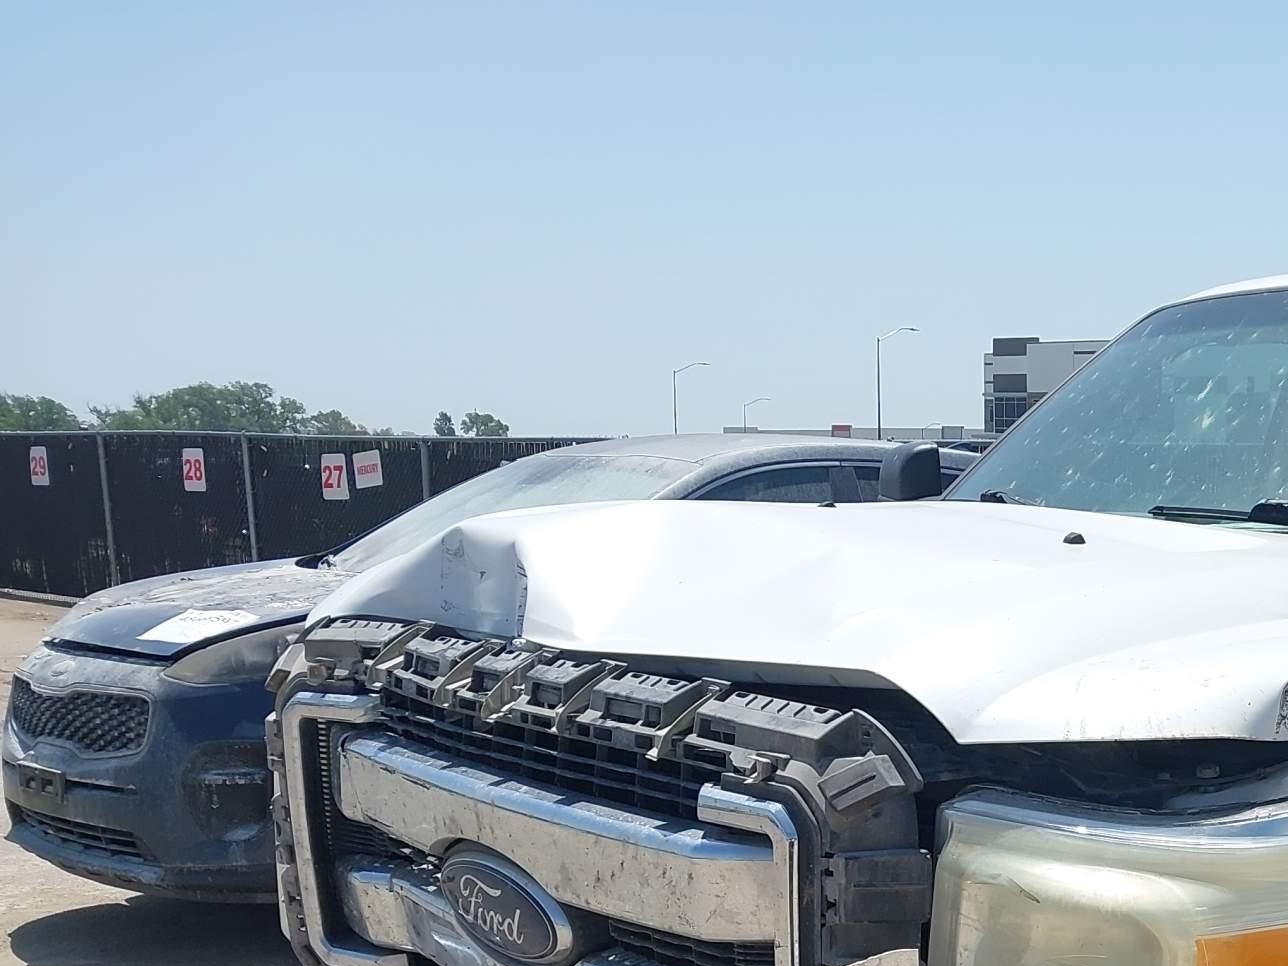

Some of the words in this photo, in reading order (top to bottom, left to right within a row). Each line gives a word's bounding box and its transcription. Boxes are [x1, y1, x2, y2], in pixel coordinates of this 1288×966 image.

[31, 456, 47, 476] 29
[184, 459, 203, 481] 28
[323, 465, 344, 489] 27
[458, 874, 524, 945] Ford
